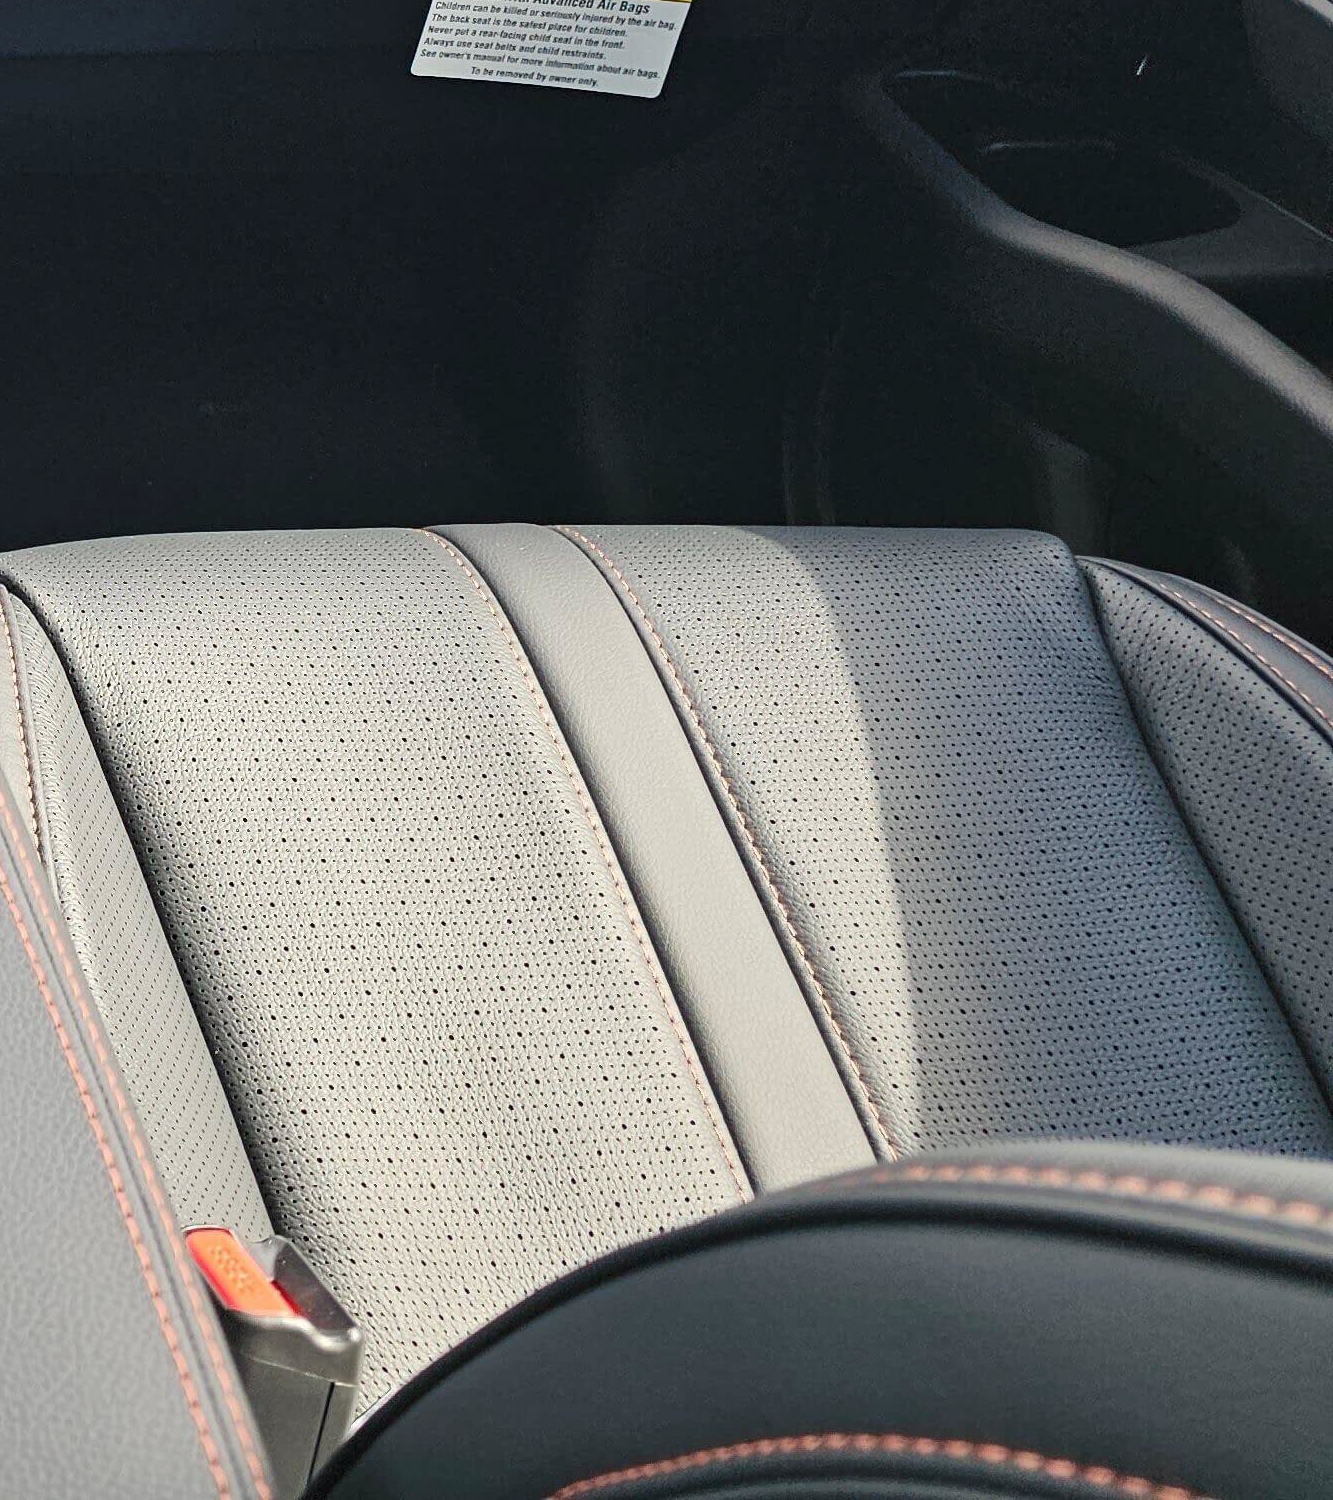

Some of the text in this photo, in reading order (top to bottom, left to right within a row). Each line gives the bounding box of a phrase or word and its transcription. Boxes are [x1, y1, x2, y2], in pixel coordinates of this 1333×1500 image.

[435, 2, 471, 11] Children
[490, 5, 501, 13] be
[503, 6, 529, 16] killed
[540, 9, 581, 21] seriously
[582, 12, 614, 24] injured
[615, 16, 627, 26] by
[627, 18, 641, 26] the
[643, 20, 657, 28] air
[657, 21, 677, 31] bag.
[597, 0, 617, 10] Air
[619, 0, 651, 16] Bags
[433, 14, 628, 37] The back seat is the safest place for children.
[428, 26, 453, 34] Never
[455, 28, 469, 37] put
[529, 33, 551, 44] child
[553, 35, 573, 44] seat
[574, 36, 583, 45] in
[585, 38, 599, 46] the
[601, 38, 625, 50] front.
